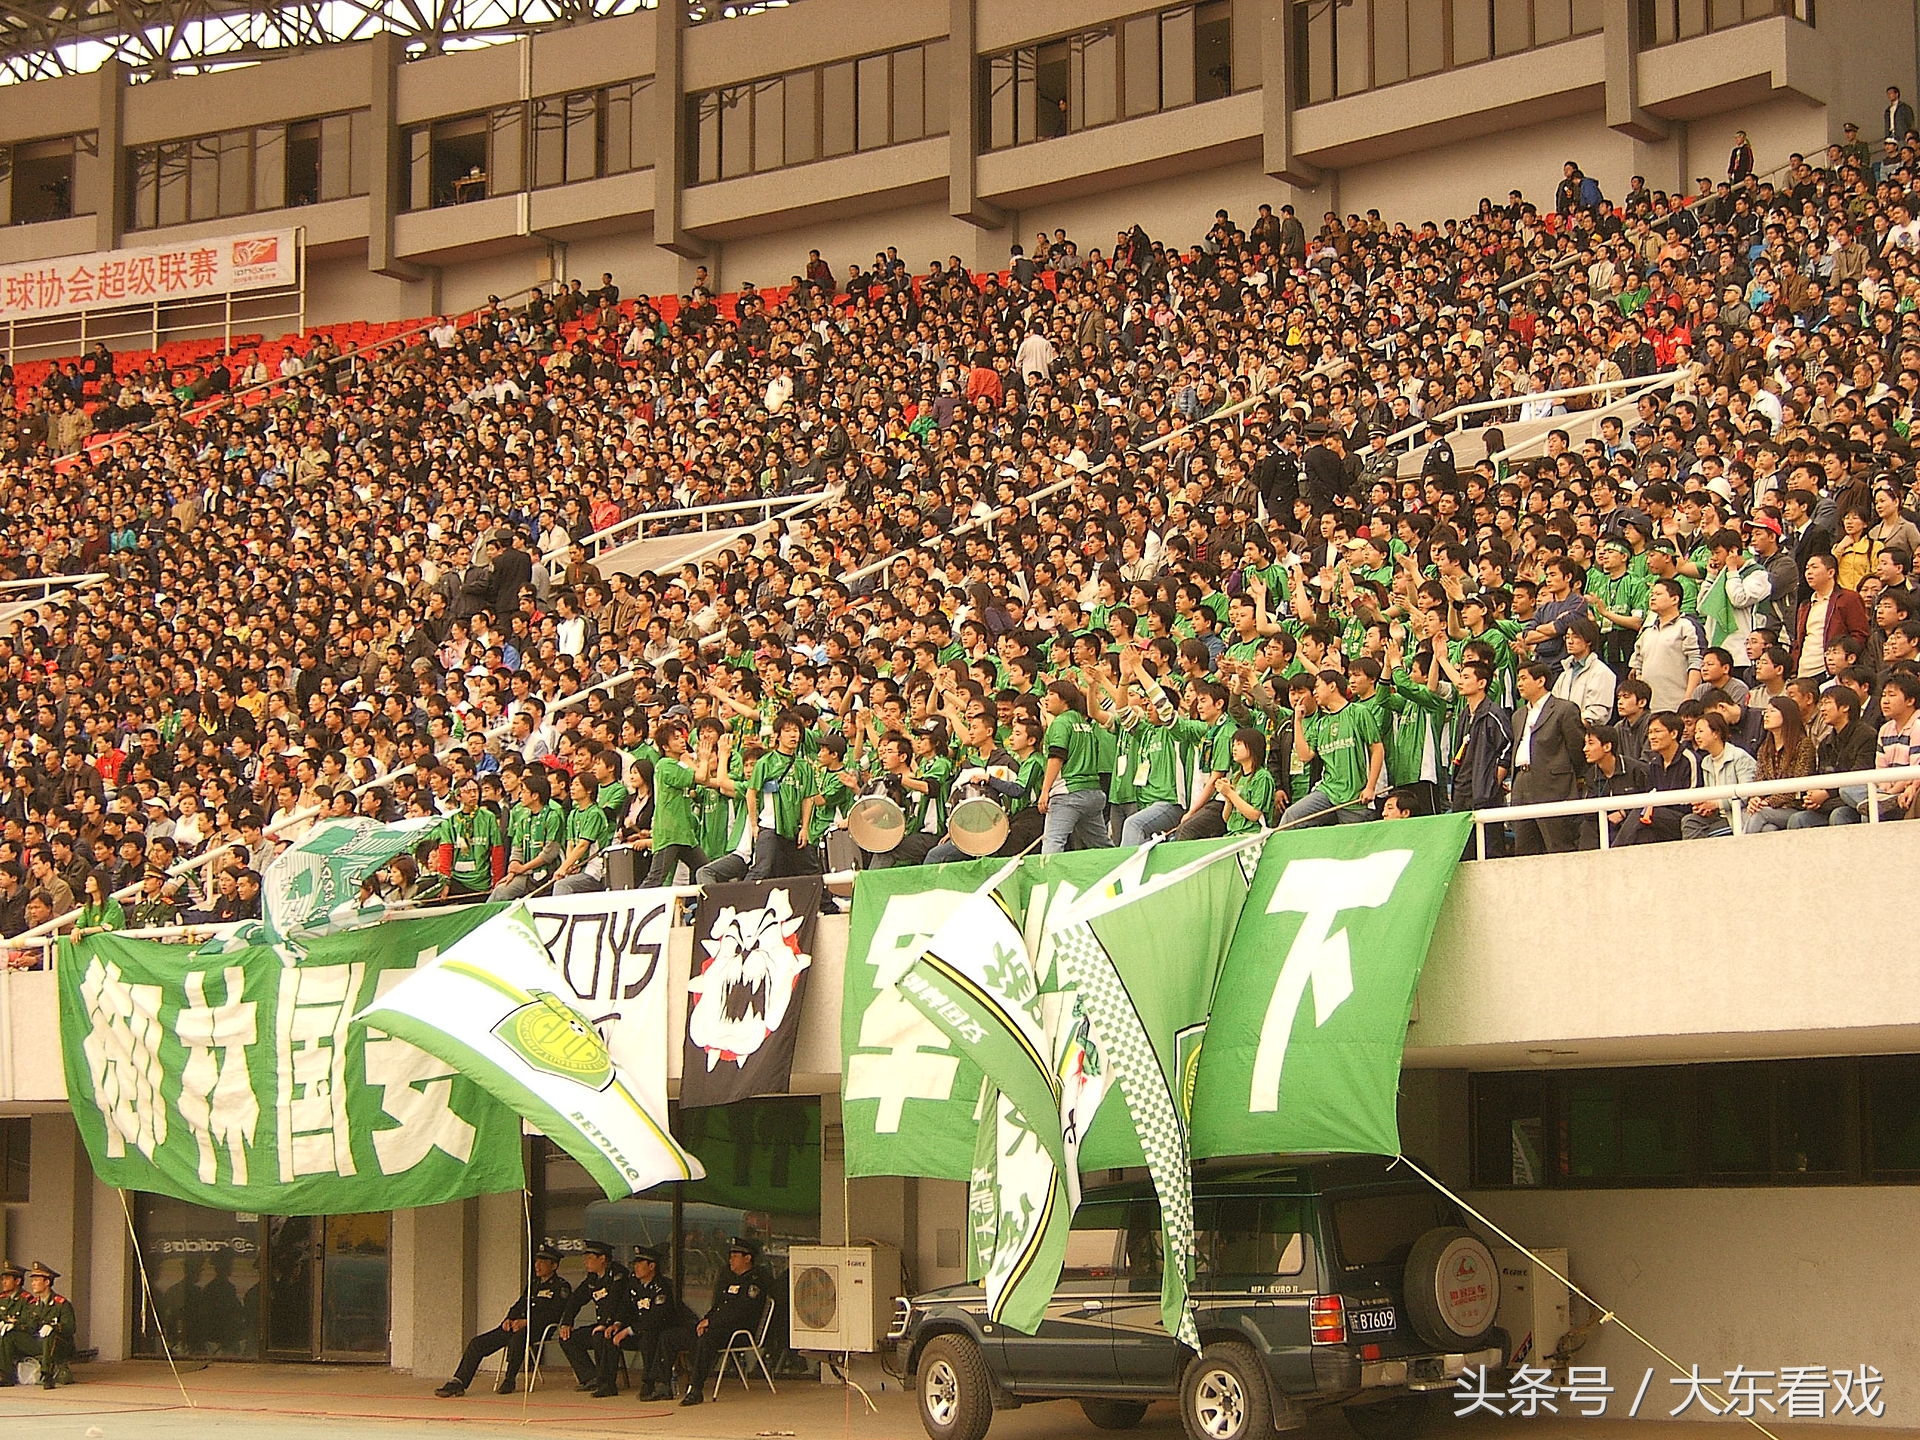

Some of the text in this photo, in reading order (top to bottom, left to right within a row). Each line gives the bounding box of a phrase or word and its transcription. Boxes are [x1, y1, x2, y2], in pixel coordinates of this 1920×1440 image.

[0, 248, 218, 313] 球协会超级联赛
[1270, 1285, 1290, 1294] EURO
